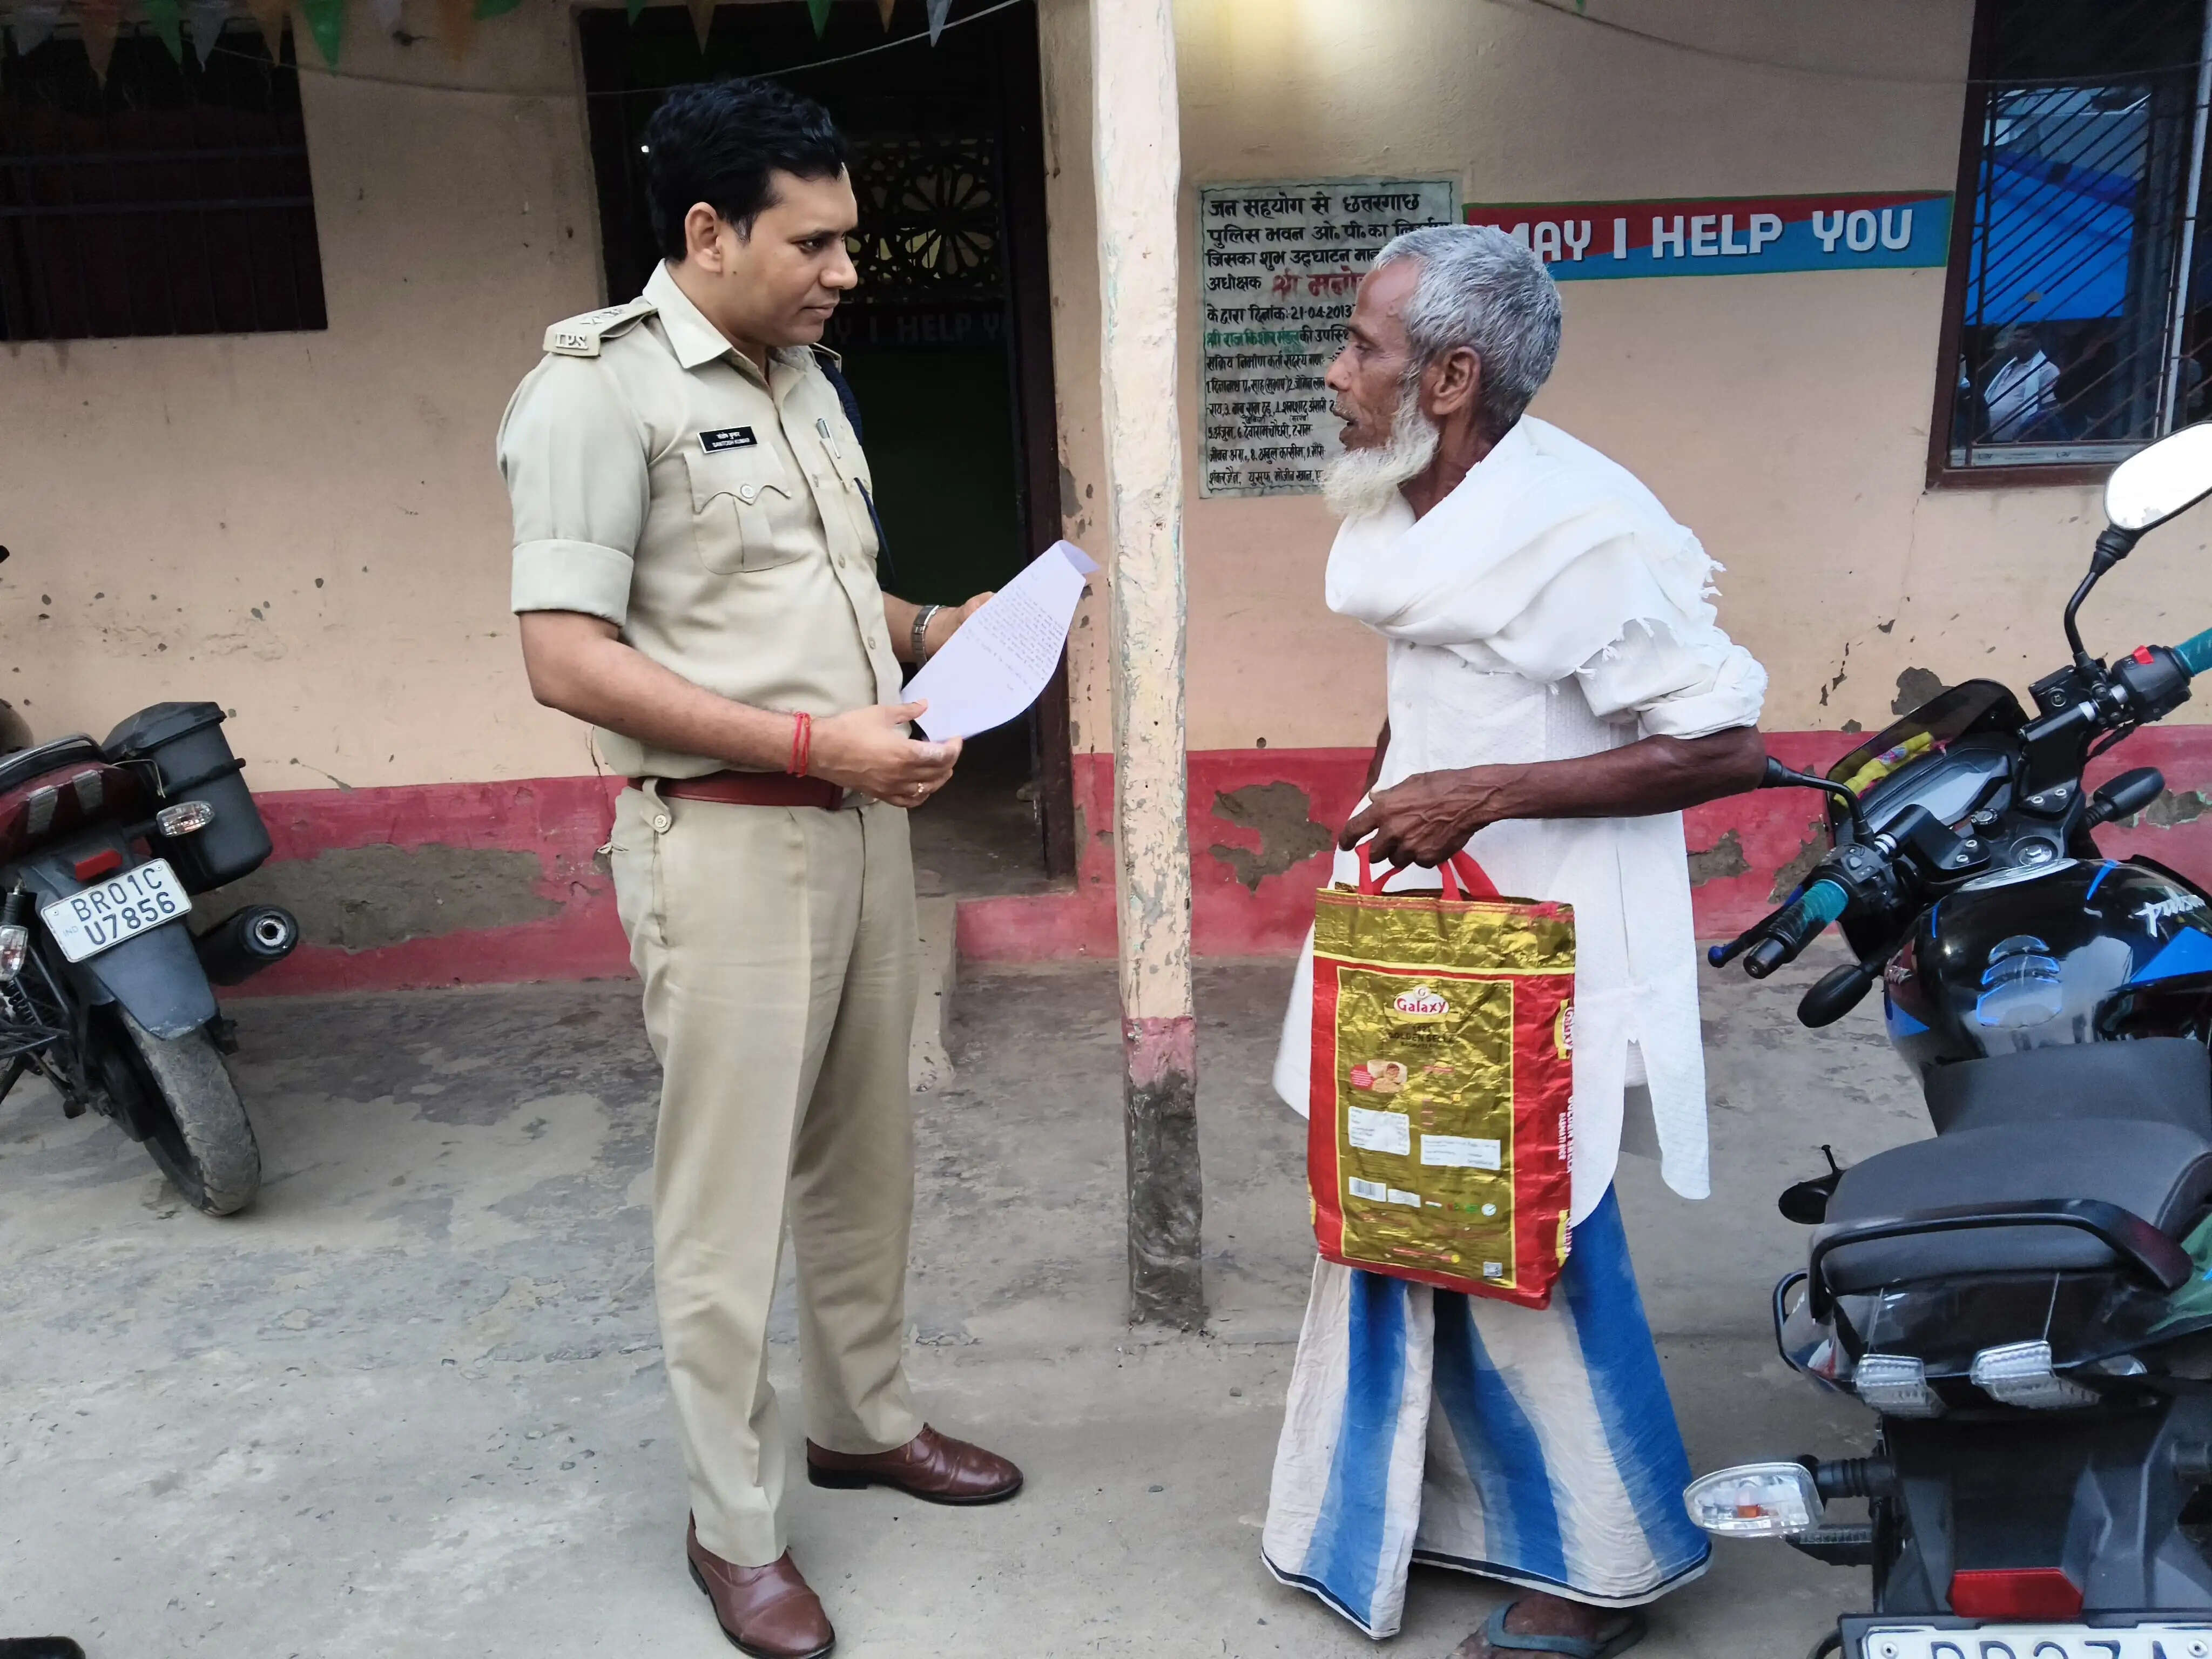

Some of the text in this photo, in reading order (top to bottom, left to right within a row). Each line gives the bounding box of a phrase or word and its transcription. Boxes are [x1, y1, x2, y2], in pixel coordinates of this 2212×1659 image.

[1210, 199, 1238, 217] जन
[1244, 192, 1305, 219] सहयोग
[1310, 191, 1332, 215] से
[1207, 224, 1261, 249] पुलिस
[1265, 227, 1306, 241] भवन
[1614, 218, 1627, 260] I
[1652, 213, 1784, 259] HELP
[1812, 209, 1913, 252] YOU
[1205, 249, 1258, 267] जिसका
[1259, 251, 1287, 271] शुभ
[1206, 273, 1262, 291] अधीक्षक
[71, 868, 162, 922] BR01C
[85, 892, 176, 945] U7856
[1397, 998, 1446, 1013] Galaxy
